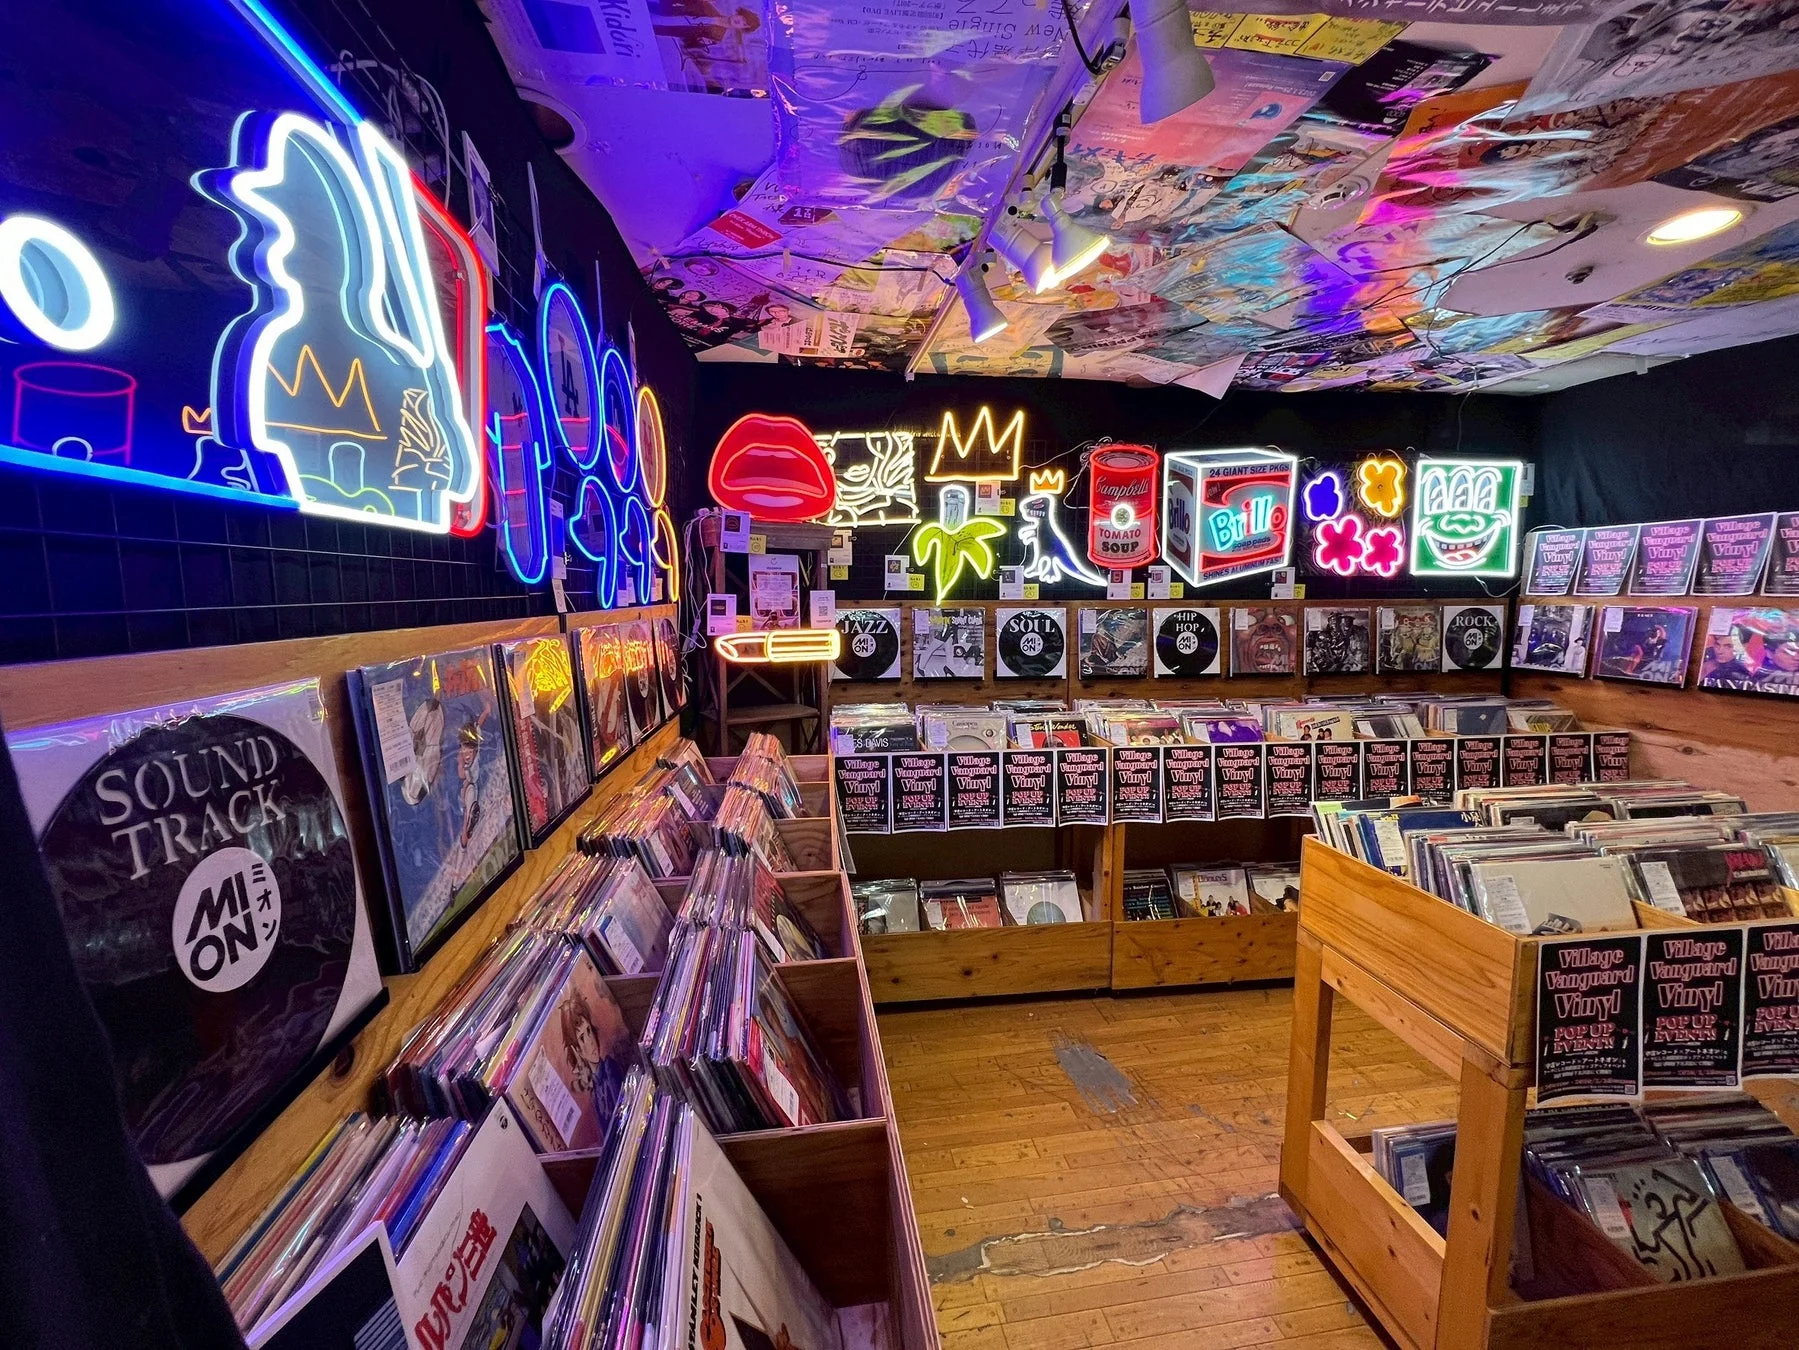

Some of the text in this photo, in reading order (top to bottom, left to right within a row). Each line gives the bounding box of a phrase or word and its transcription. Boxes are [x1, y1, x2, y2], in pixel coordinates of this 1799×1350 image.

[948, 17, 1069, 42] New Single
[1209, 469, 1221, 478] 24
[1222, 467, 1249, 477] GIANT
[1250, 464, 1268, 474] SIZE
[1168, 496, 1191, 535] Brillo
[1208, 494, 1288, 552] Brillo
[1099, 527, 1142, 540] TOMATO
[1101, 540, 1141, 554] SOUP
[1713, 541, 1758, 557] Vinyl
[1203, 567, 1230, 581] SHINES
[1231, 560, 1266, 575] ALUMINUM
[1177, 612, 1198, 622] HIP
[1454, 615, 1494, 628] ROCK
[841, 619, 889, 635] JAZZ
[1009, 618, 1056, 633] SOUL
[1175, 622, 1200, 632] HOP
[854, 638, 869, 646] MI
[1022, 637, 1036, 645] MI
[1178, 636, 1192, 644] MI
[866, 737, 889, 748] DAVIS
[1371, 744, 1400, 754] Village
[1417, 743, 1447, 753] Village
[1464, 740, 1494, 751] Village
[1511, 739, 1539, 749] Village
[1556, 737, 1584, 748] Village
[1119, 750, 1152, 761] Village
[1171, 750, 1204, 760] Village
[1222, 748, 1254, 758] Village
[1273, 747, 1304, 757] Village
[1322, 745, 1353, 756] Village
[844, 760, 879, 770] Village
[901, 758, 936, 768] Village
[957, 756, 991, 766] Village
[1011, 755, 1046, 765] Village
[1065, 753, 1099, 763] Village
[1166, 758, 1209, 770] Vanguard
[1217, 758, 1260, 768] Vanguard
[1268, 756, 1310, 767] Vanguard
[1317, 754, 1358, 765] Vanguard
[1366, 753, 1405, 763] Vanguard
[1509, 758, 1539, 772] Vinyl
[1555, 756, 1583, 771] Vinyl
[895, 767, 942, 778] Vanguard
[951, 766, 997, 777] Vanguard
[1005, 764, 1051, 775] Vanguard
[1060, 762, 1104, 773] Vanguard
[1115, 760, 1157, 771] Vanguard
[1322, 764, 1352, 779] Vinyl
[1370, 763, 1400, 778] Vinyl
[1416, 762, 1447, 777] Vinyl
[1463, 760, 1492, 775] Vinyl
[838, 769, 886, 780] Vanguard
[1065, 772, 1098, 788] Vinyl
[1119, 771, 1152, 784] Vinyl
[1170, 769, 1204, 784] Vinyl
[1222, 767, 1254, 782] Vinyl
[1273, 767, 1305, 781] Vinyl
[95, 735, 281, 828] SOUND
[845, 780, 880, 796] Vinyl
[901, 779, 936, 794] Vinyl
[957, 776, 992, 791] Vinyl
[1011, 775, 1046, 790] Vinyl
[110, 780, 287, 881] TRACK
[186, 875, 250, 944] MI
[252, 862, 279, 943] ミオン
[190, 910, 258, 982] ON
[1663, 939, 1727, 960] Village
[1559, 948, 1624, 969] Village
[1650, 958, 1737, 981] Vanguard
[1546, 965, 1634, 990] Vanguard
[1658, 981, 1723, 1012] Vinyl
[1555, 989, 1621, 1021] Vinyl
[1656, 1014, 1718, 1030] POP UP
[1554, 1023, 1616, 1040] POP UP
